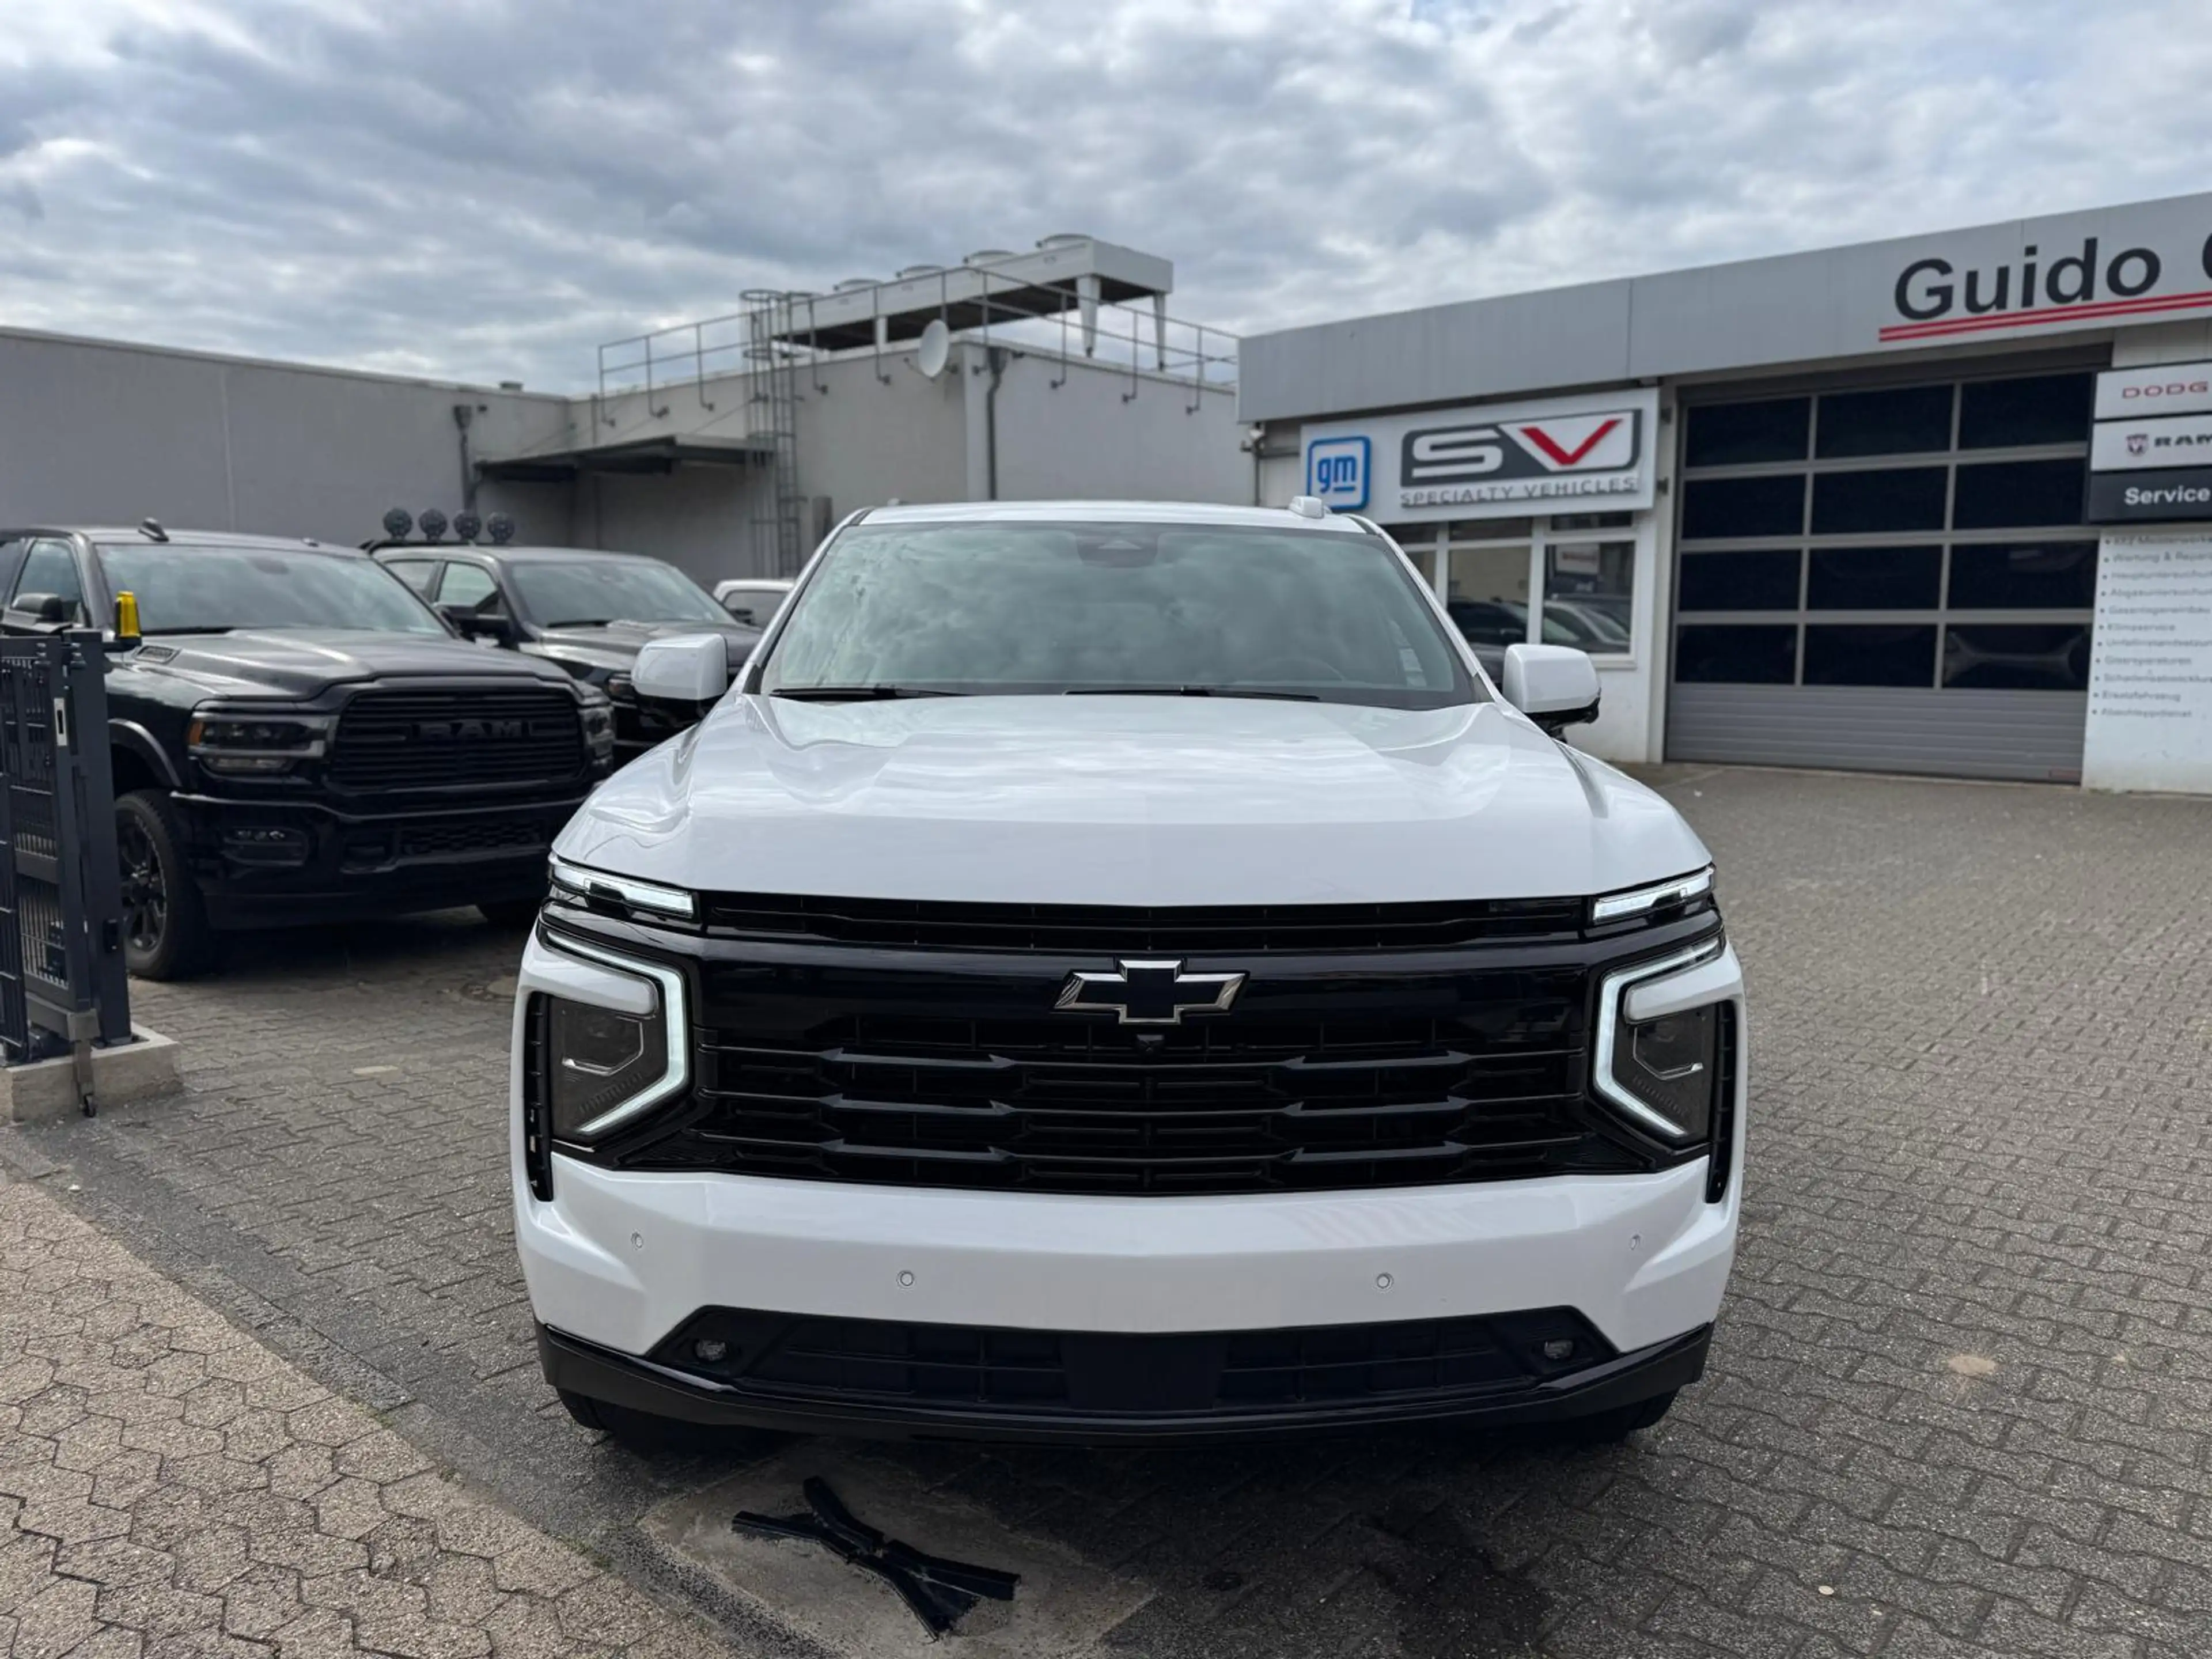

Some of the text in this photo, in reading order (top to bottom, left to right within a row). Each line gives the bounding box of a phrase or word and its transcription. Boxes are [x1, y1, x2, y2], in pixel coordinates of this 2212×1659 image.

[1895, 237, 2161, 320] Guido
[1411, 418, 1624, 478] SV
[1318, 456, 1356, 494] gm
[1400, 476, 1639, 507] SPECIALTY VEHICLES
[2124, 486, 2211, 506] Service
[419, 719, 522, 740] RAM
